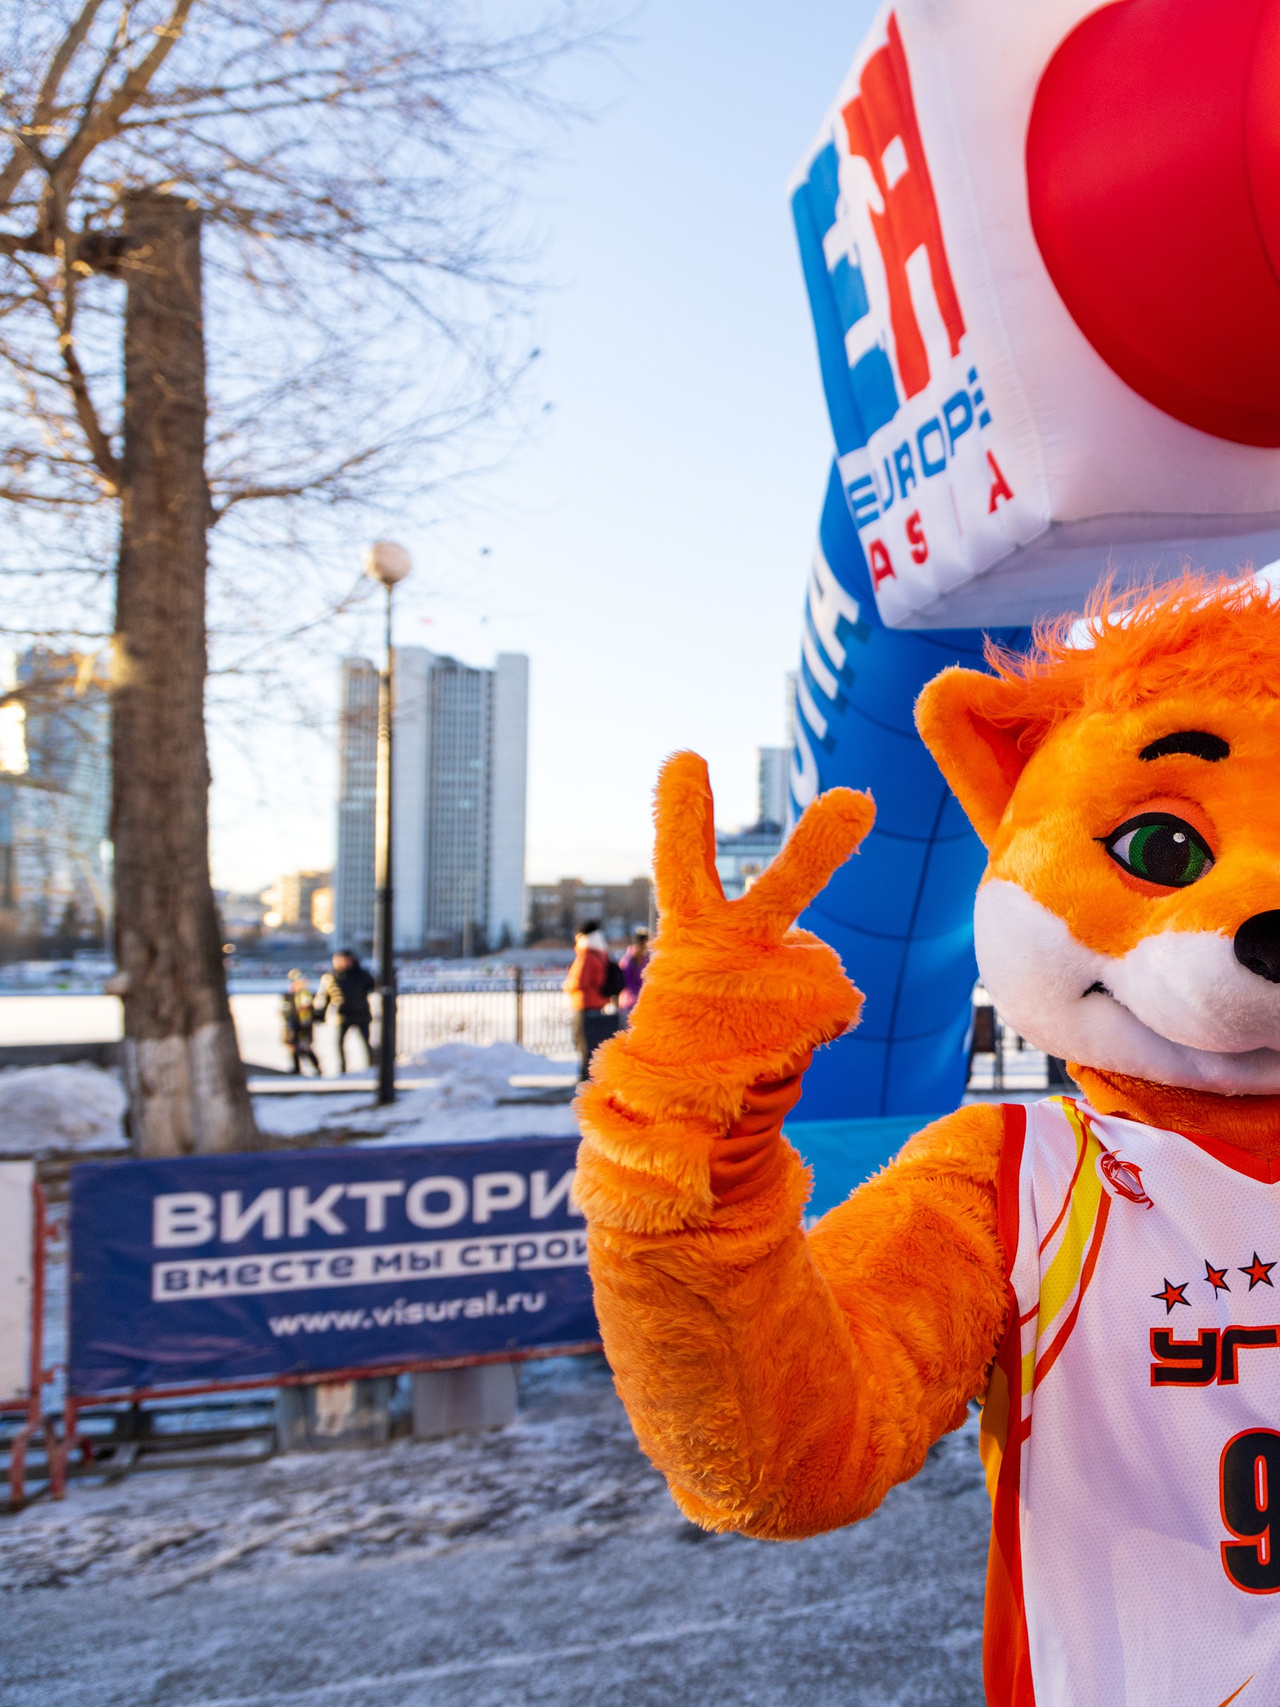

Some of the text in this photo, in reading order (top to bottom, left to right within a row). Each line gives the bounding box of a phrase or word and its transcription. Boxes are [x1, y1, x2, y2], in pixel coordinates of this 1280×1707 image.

[162, 1254, 357, 1293] вместе
[370, 1248, 443, 1277] мы
[267, 1289, 547, 1338] www.visural.ru
